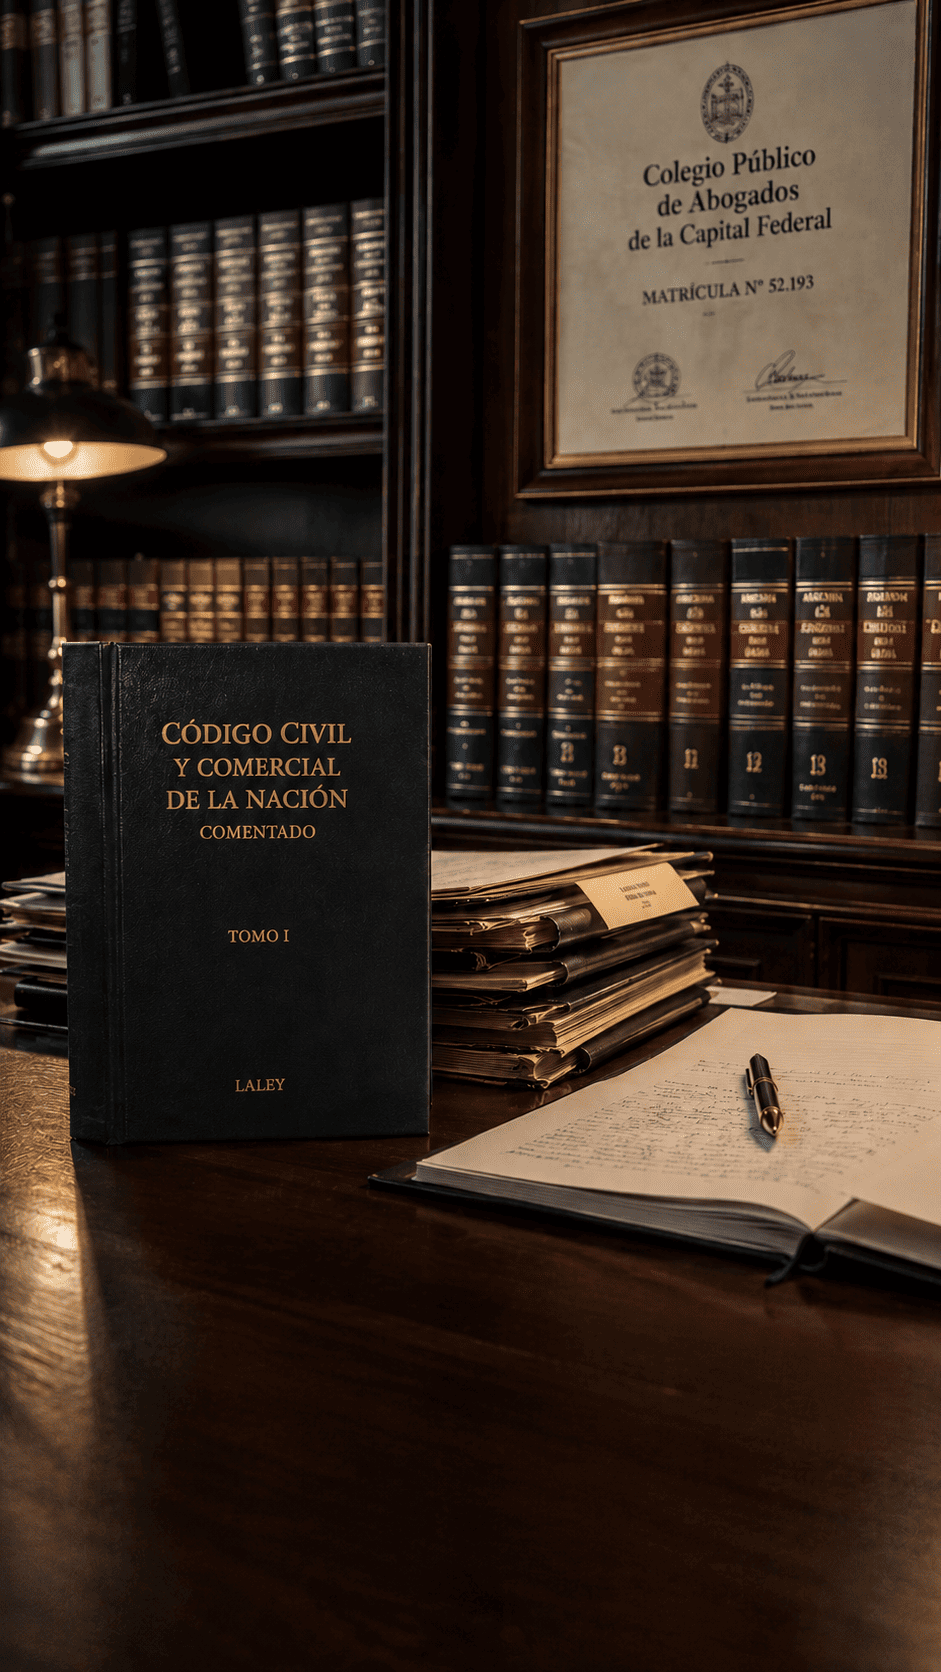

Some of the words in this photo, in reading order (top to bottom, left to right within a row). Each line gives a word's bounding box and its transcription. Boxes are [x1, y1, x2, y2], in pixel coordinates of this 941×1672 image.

[643, 156, 725, 187] Colegio
[732, 145, 816, 176] Público
[657, 193, 683, 217] de
[688, 180, 800, 213] Abogados
[628, 229, 651, 251] de
[656, 226, 674, 248] la
[679, 216, 750, 249] Capital
[757, 206, 832, 237] Federal
[642, 282, 741, 305] MATRÍCULA
[768, 274, 814, 293] 52.193
[161, 718, 273, 745] CÓDIGO
[280, 721, 352, 745] CIVIL
[173, 758, 191, 777] Y
[197, 757, 341, 778] COMERCIAL
[166, 790, 201, 810] DE
[207, 789, 240, 810] LA
[245, 783, 349, 809] NACIÓN
[199, 824, 316, 840] COMENTADO
[227, 929, 279, 943] TOMO
[283, 929, 290, 943] I
[235, 1078, 286, 1093] LALEY
